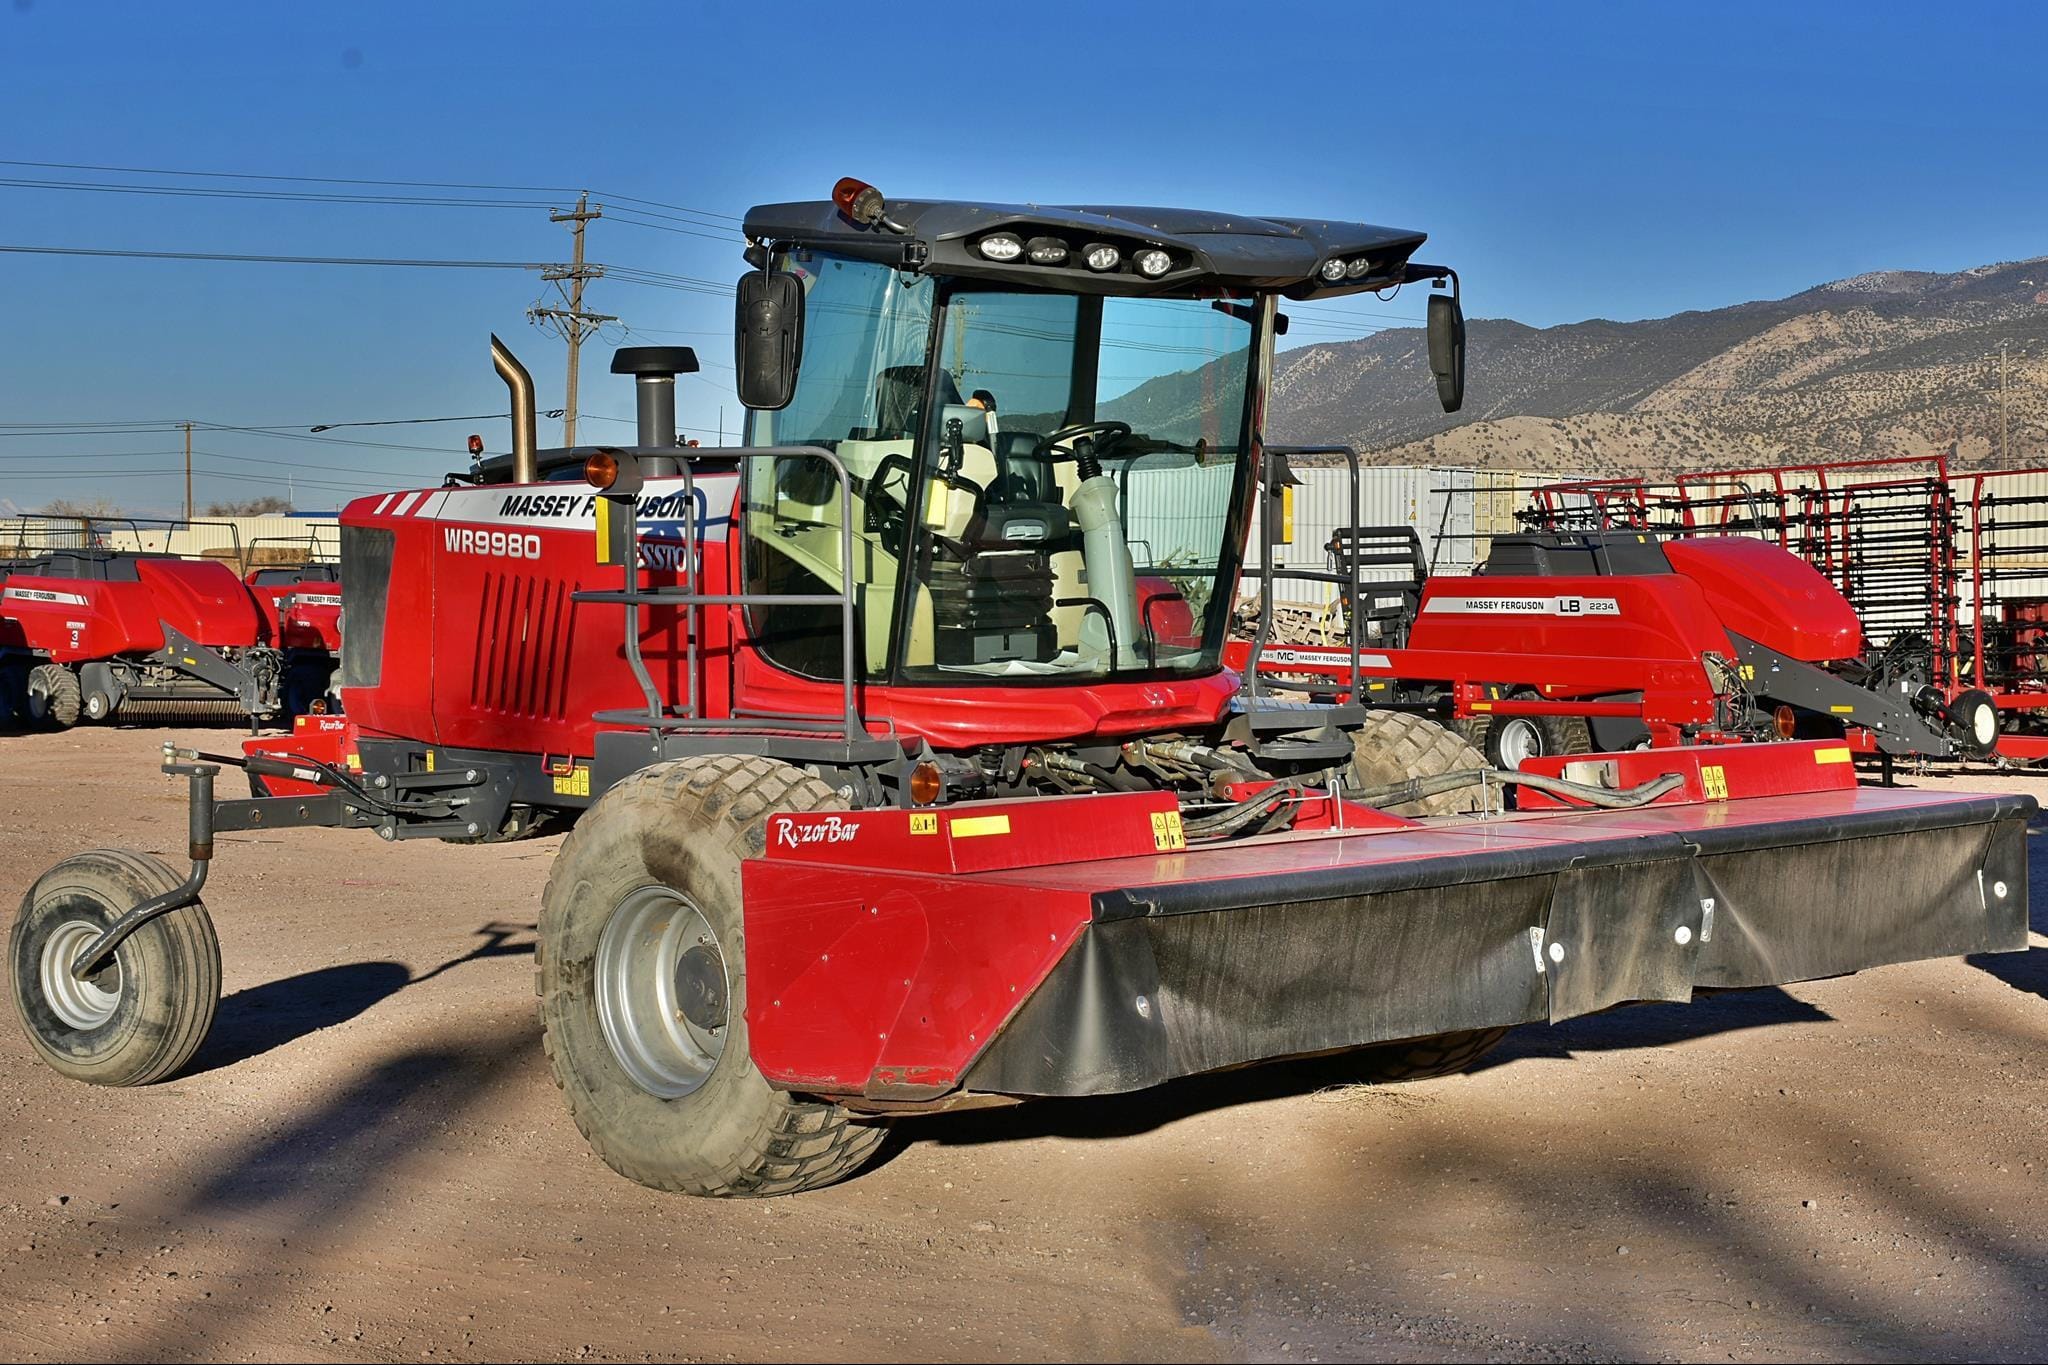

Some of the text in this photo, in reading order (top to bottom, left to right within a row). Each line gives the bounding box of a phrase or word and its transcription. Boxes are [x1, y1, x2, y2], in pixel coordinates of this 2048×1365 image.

[499, 495, 687, 518] MASSEY FUSON
[444, 527, 541, 560] WR9980
[1465, 599, 1614, 612] MASSEY FERGUSON LB 2234
[1277, 651, 1294, 661] MC
[1322, 655, 1352, 663] FERGUSON
